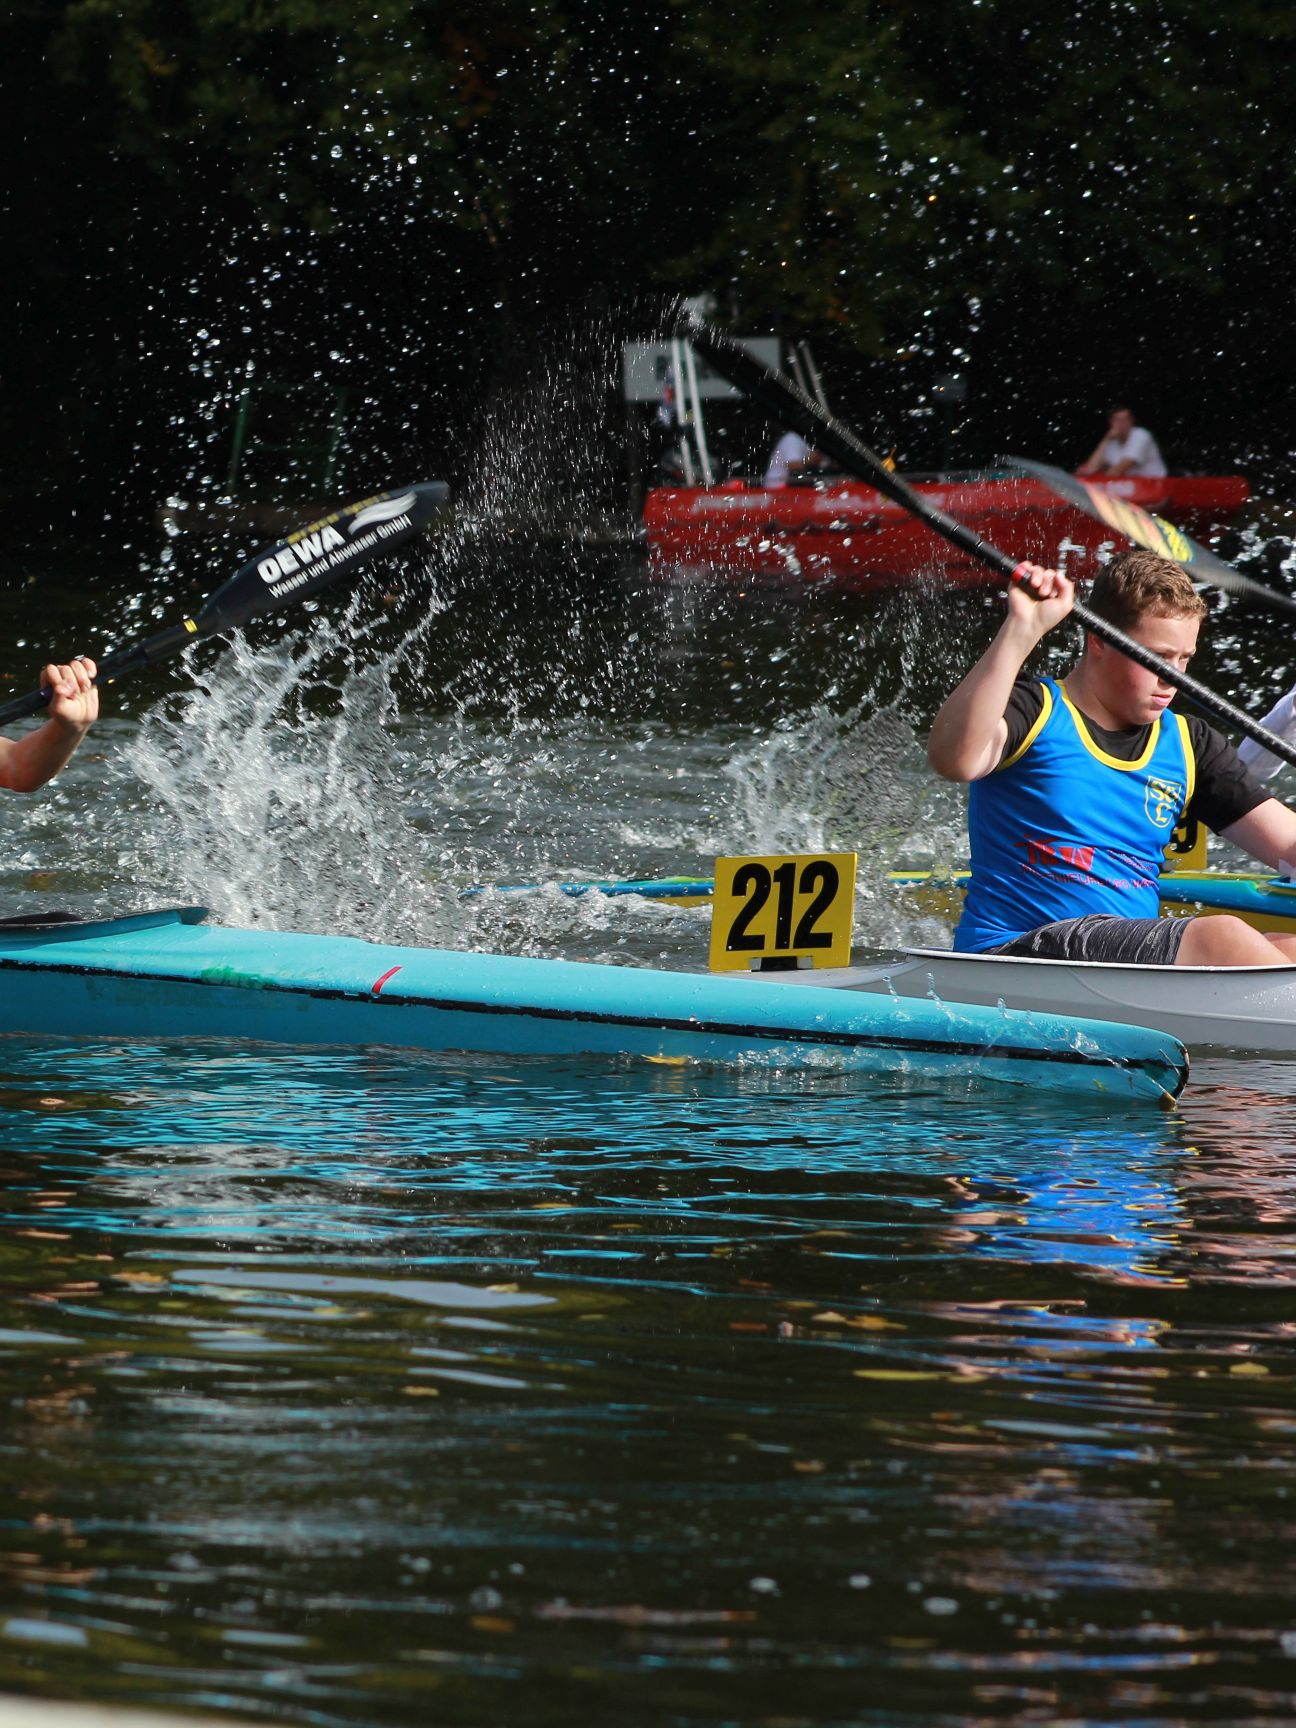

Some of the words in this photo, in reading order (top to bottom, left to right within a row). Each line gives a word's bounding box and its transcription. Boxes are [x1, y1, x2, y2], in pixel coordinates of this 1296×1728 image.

[257, 525, 346, 584] OEWA
[308, 557, 331, 578] und
[376, 513, 413, 540] GmbH
[726, 860, 840, 952] 212
